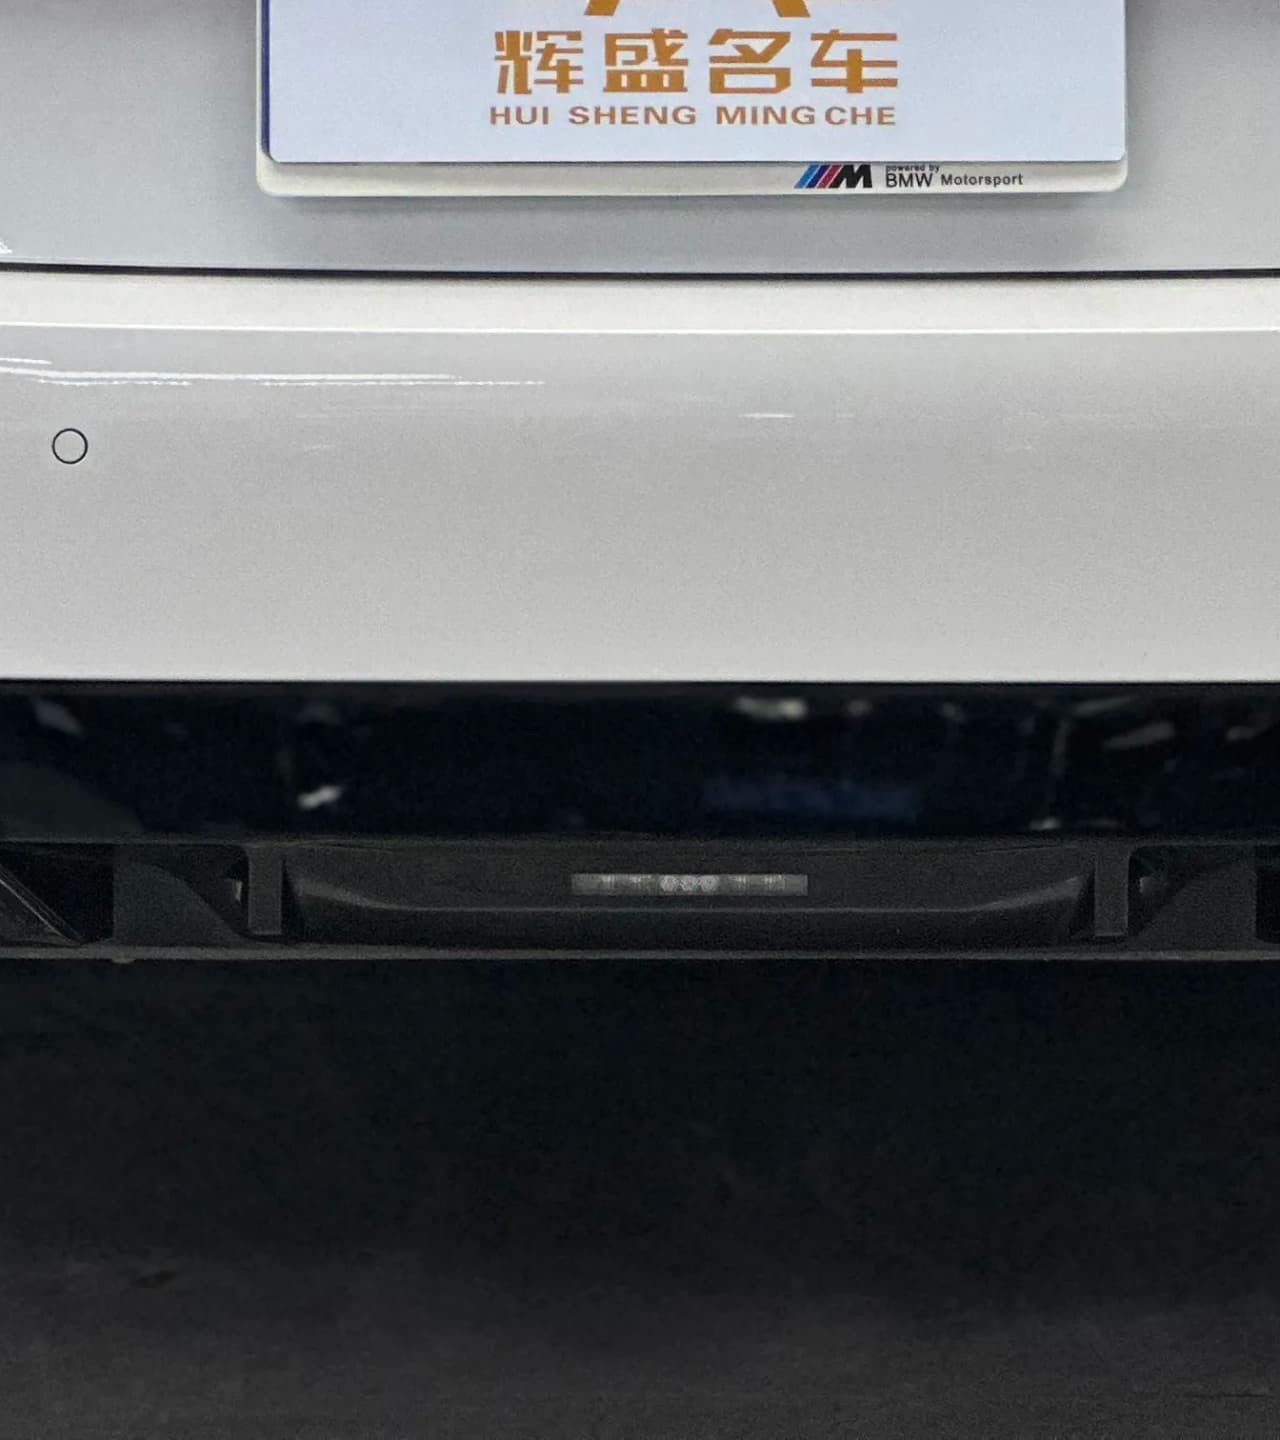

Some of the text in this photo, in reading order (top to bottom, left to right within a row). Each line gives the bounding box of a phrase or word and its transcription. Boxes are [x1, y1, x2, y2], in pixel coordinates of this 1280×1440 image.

[494, 28, 899, 94] 辉盛名车
[490, 106, 896, 125] HUI SHENG MING CHE
[885, 164, 940, 173] powered by
[885, 173, 1024, 188] BMW Motorsport
